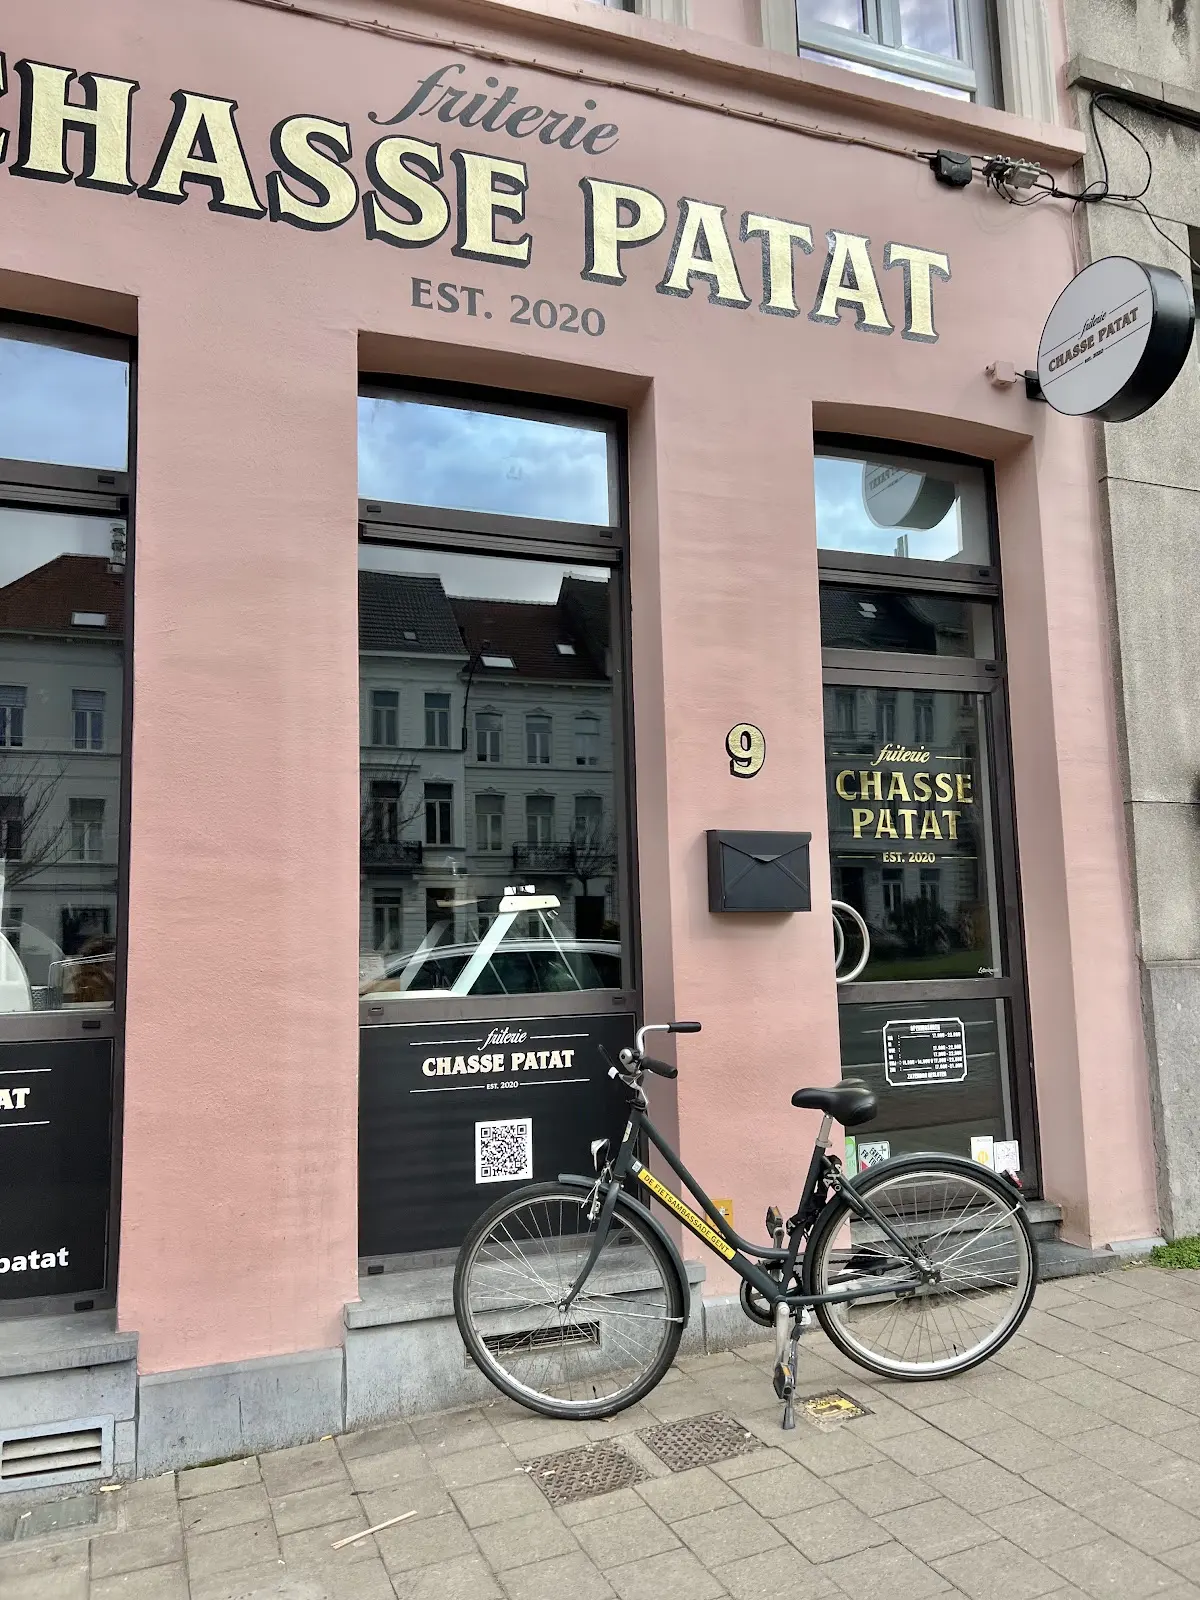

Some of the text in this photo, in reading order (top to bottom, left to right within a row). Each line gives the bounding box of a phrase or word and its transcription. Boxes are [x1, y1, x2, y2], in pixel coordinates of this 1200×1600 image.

[368, 63, 620, 156] friterie
[0, 51, 952, 344] HASSE PATAT
[410, 277, 606, 337] EST. 2020
[1048, 307, 1139, 372] CHASSE PATAT
[725, 722, 766, 779] 9
[870, 743, 930, 766] friterie
[835, 770, 974, 804] CHASSE
[851, 808, 962, 840] PATAT
[882, 852, 936, 863] EST. 2020
[477, 1026, 528, 1051] friterie
[422, 1050, 575, 1077] CHASSE PATAT
[500, 1081, 519, 1090] 2020
[643, 1174, 654, 1186] DE
